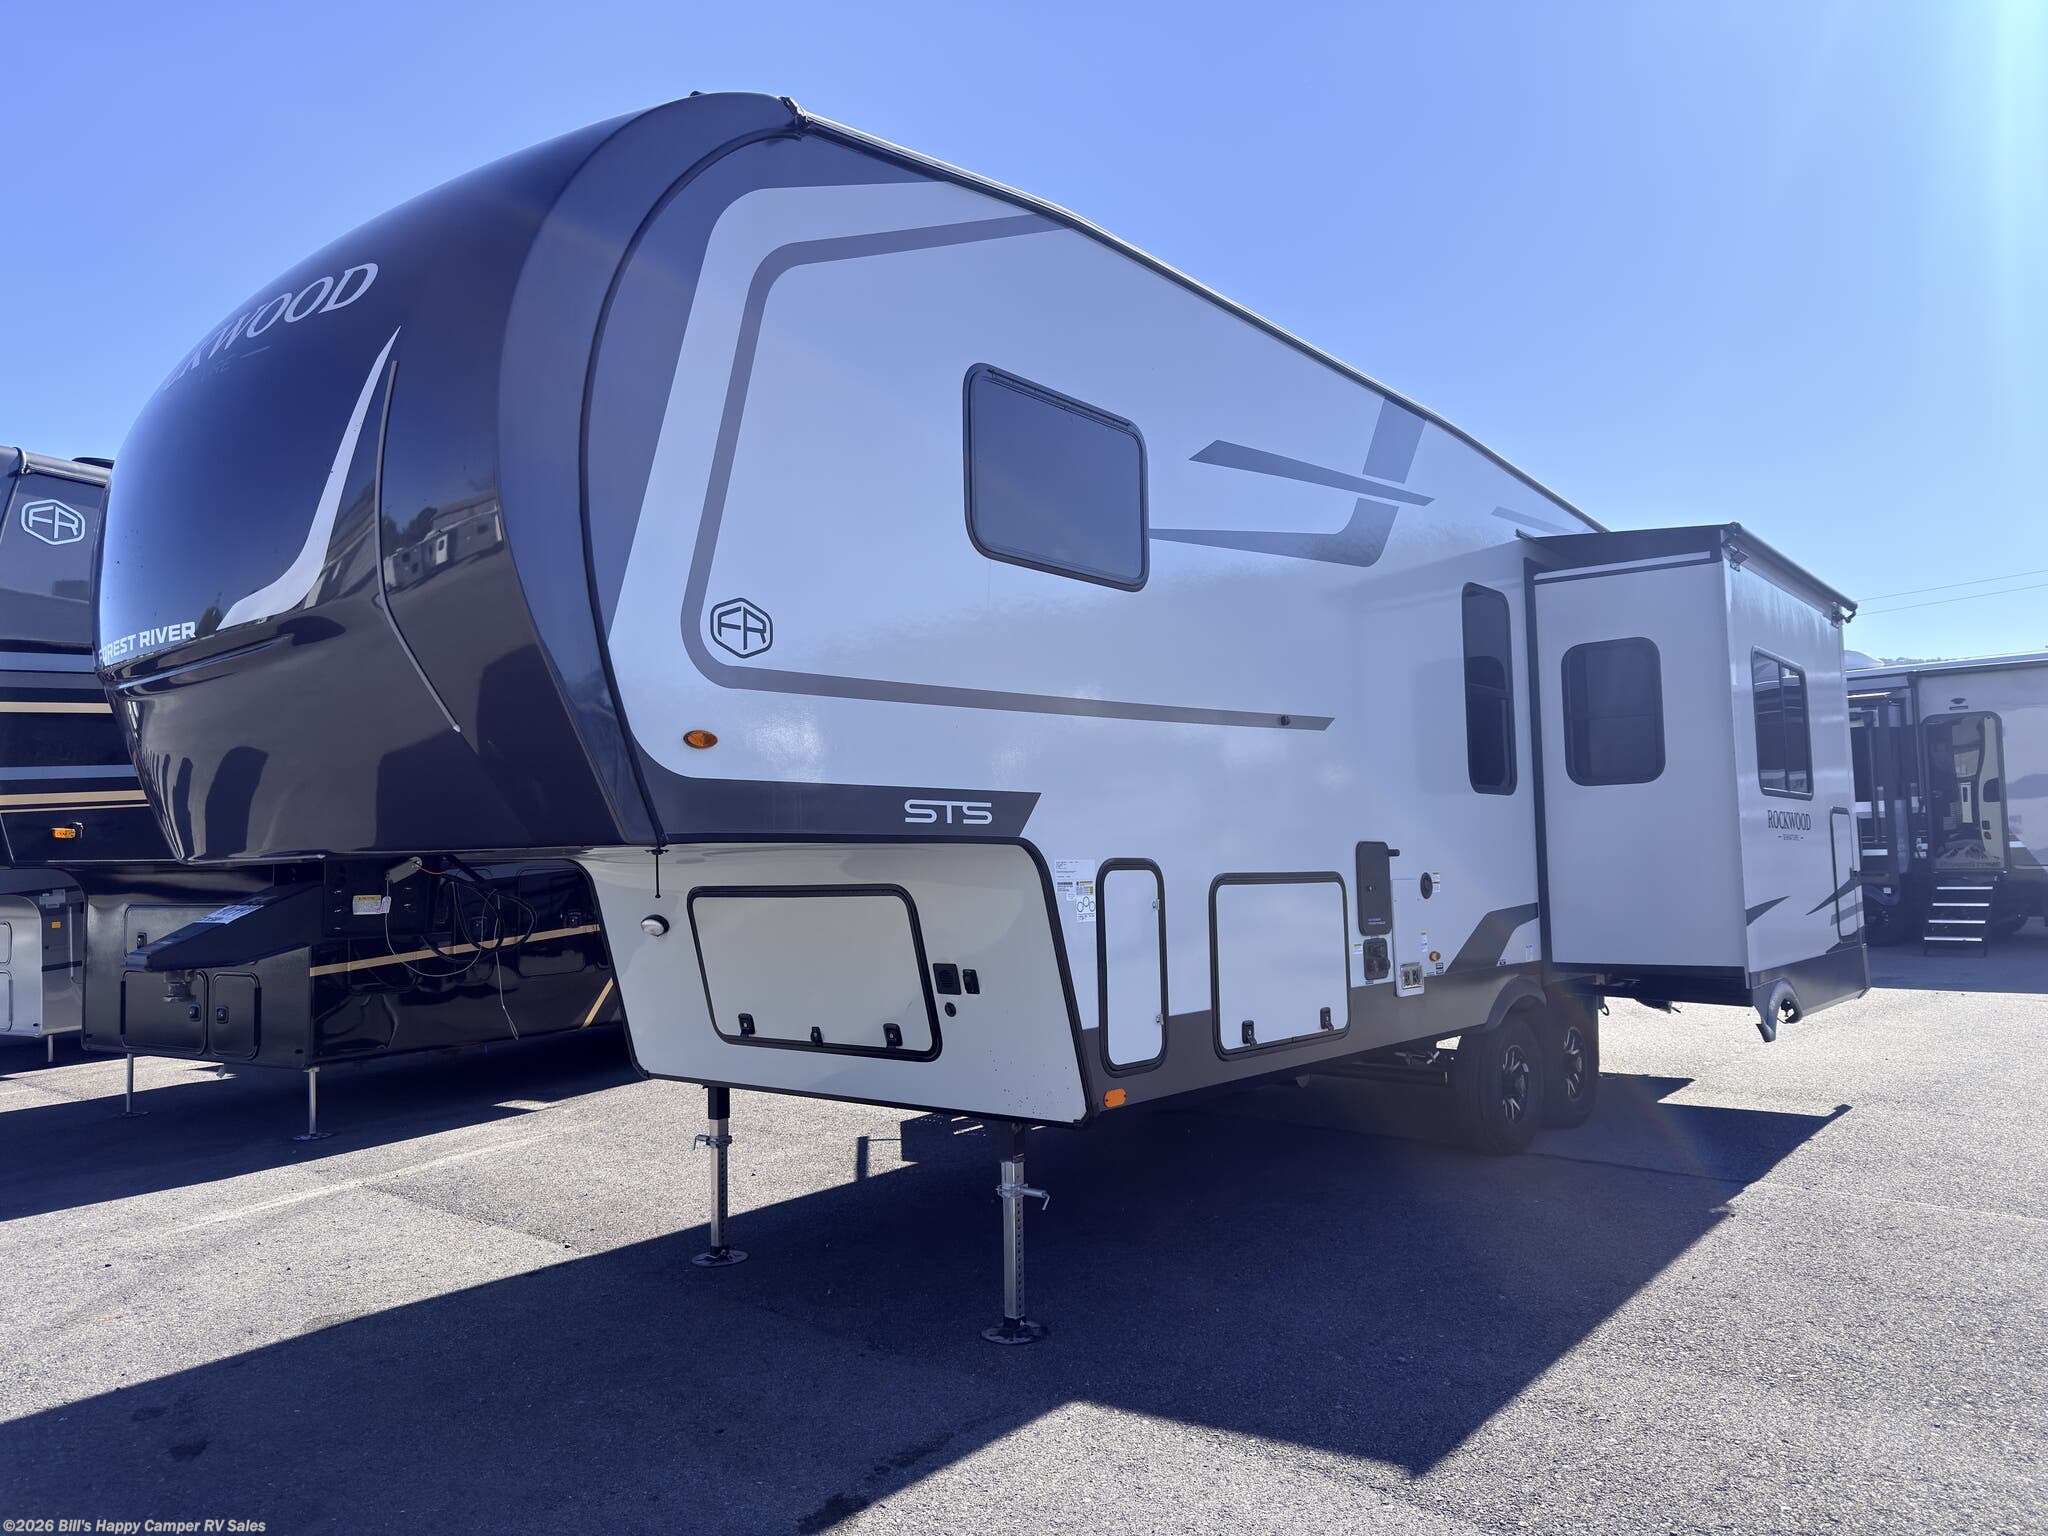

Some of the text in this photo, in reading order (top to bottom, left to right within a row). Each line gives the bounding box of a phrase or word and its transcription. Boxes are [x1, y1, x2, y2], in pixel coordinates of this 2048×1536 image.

[28, 505, 79, 539] FR
[138, 621, 197, 648] RIVER
[717, 605, 767, 650] FR
[904, 799, 993, 825] STS
[1767, 809, 1812, 831] ROCKWOOD
